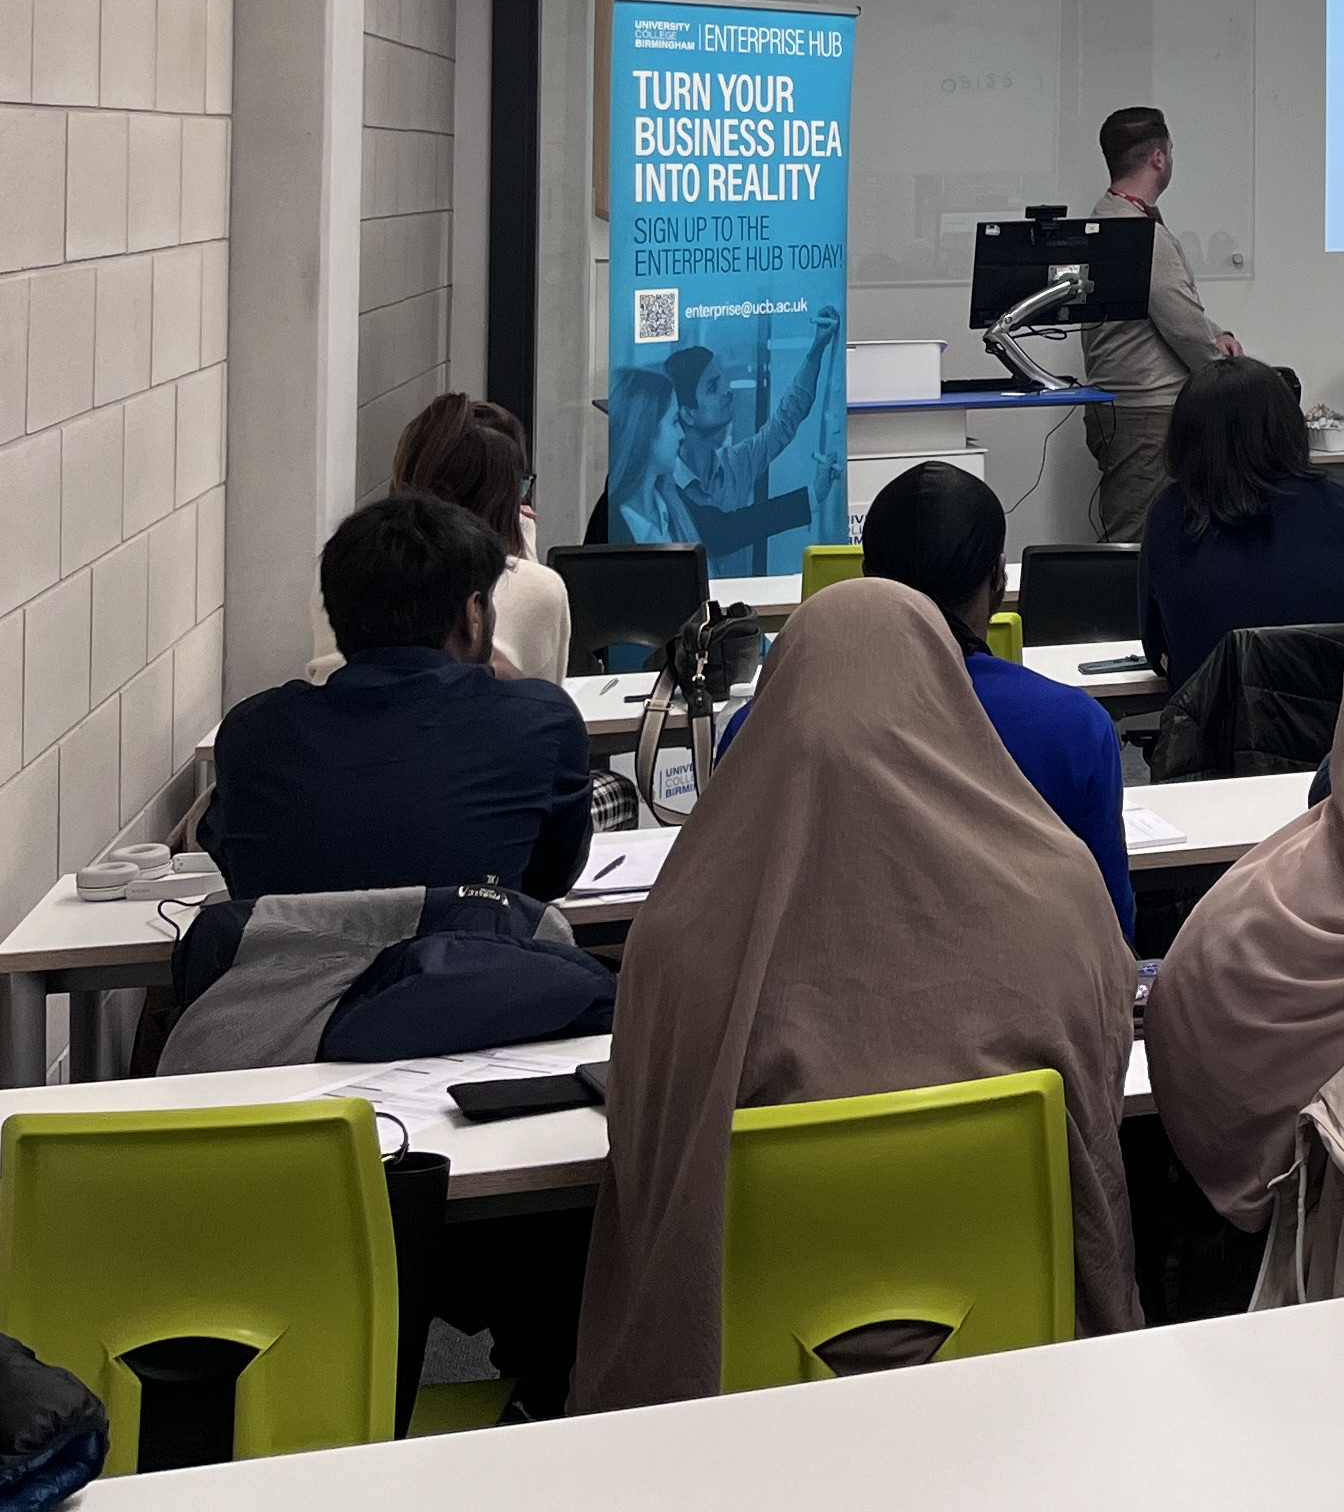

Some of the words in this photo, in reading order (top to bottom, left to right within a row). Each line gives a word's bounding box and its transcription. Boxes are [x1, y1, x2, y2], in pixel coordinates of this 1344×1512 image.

[634, 20, 690, 32] UNIVERSITY
[634, 29, 677, 39] COLLEGE
[704, 24, 805, 56] ENTERPRISE
[808, 30, 843, 58] HUB
[634, 39, 695, 50] BIRMINGHAM
[632, 70, 711, 111] TURN
[717, 73, 794, 113] YOUR
[634, 116, 776, 157] BUSINESS
[783, 119, 843, 157] IDEA
[634, 163, 700, 203] INTO
[708, 163, 821, 202] REALITY
[633, 216, 679, 245] SIGN
[684, 216, 708, 243] UP
[711, 215, 733, 242] TO
[737, 215, 770, 241] THE
[635, 246, 741, 277] ENTERPRISE
[746, 245, 783, 272] HUB
[787, 243, 843, 270] TODAY!
[685, 297, 808, 321] enterprise@ucb.ac.uk
